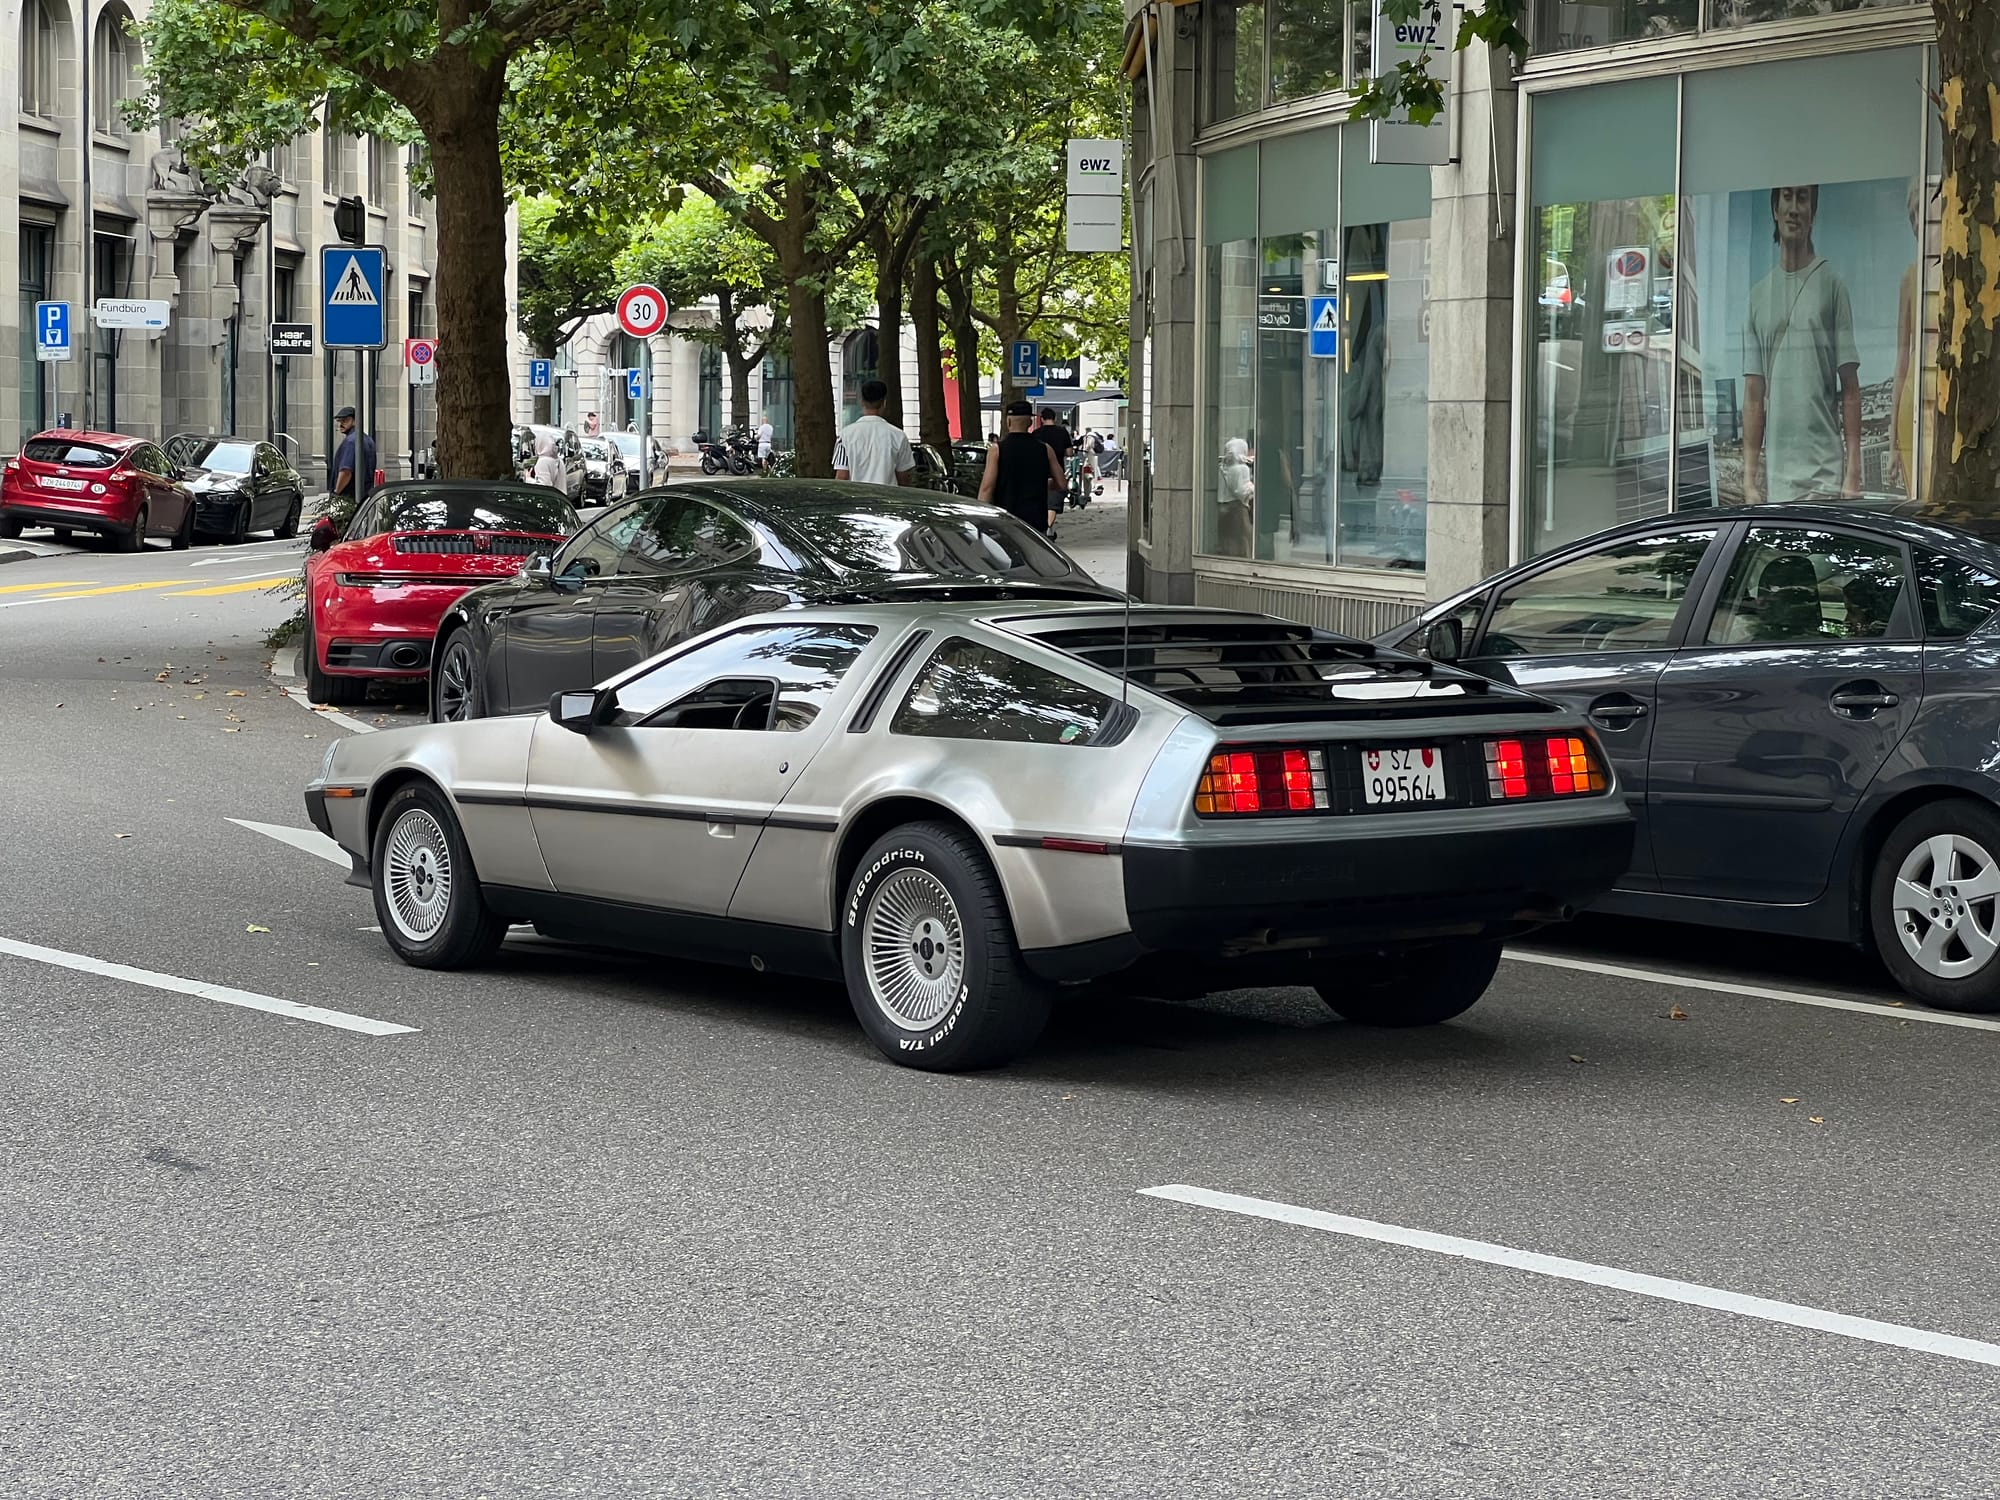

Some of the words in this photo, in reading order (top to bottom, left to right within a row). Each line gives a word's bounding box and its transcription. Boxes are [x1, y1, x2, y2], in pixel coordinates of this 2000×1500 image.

[1395, 24, 1436, 43] ewz
[1080, 158, 1110, 171] ewz
[100, 302, 147, 313] Fundbüro
[632, 303, 651, 320] 30
[47, 306, 61, 328] P
[1020, 345, 1031, 361] P
[536, 362, 545, 375] P
[1391, 750, 1412, 770] SZ
[1373, 775, 1436, 803] 99564
[848, 848, 925, 927] BFGoodrich
[930, 984, 969, 1047] Radial
[899, 1038, 925, 1051] T/A
